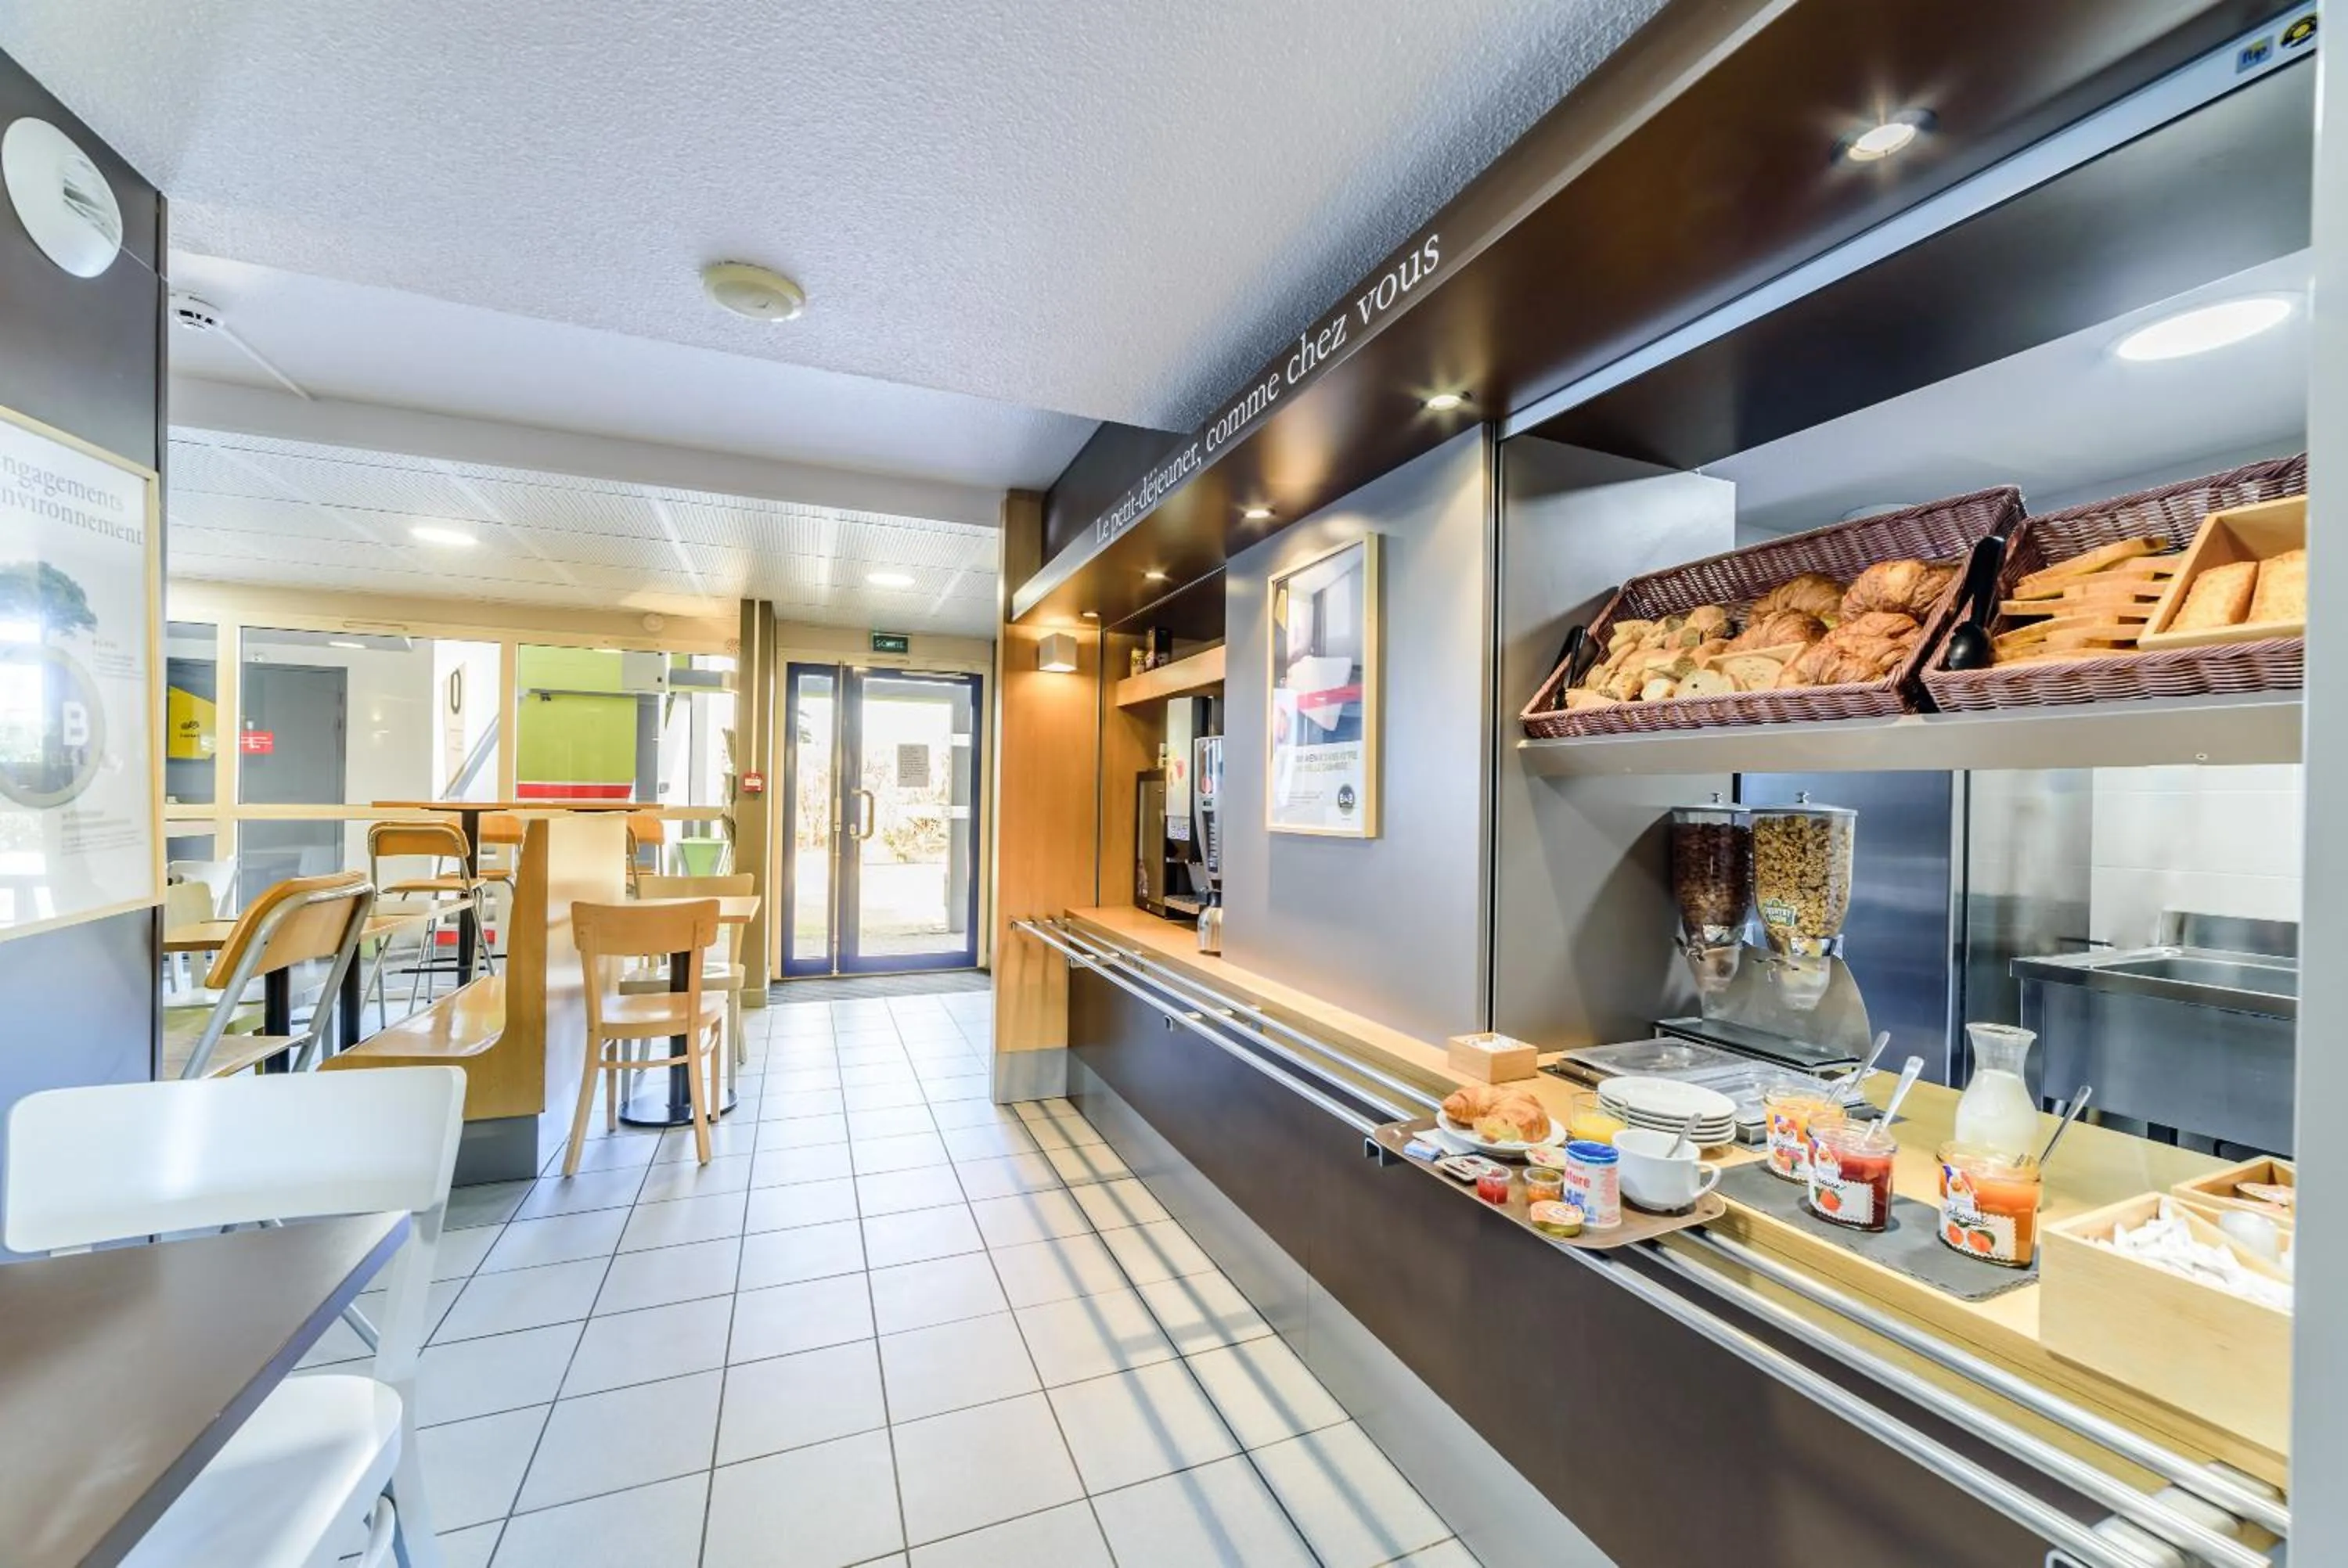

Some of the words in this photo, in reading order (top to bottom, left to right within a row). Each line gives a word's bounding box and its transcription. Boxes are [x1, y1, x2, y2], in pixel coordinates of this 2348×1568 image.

[1097, 516, 1109, 544] Le
[1111, 442, 1201, 541] petit-déjeuner,
[1206, 372, 1280, 452] comme
[1287, 313, 1347, 385] chez
[1356, 233, 1440, 325] vous
[2, 455, 125, 512] ngagements
[2, 486, 144, 546] nvironnement
